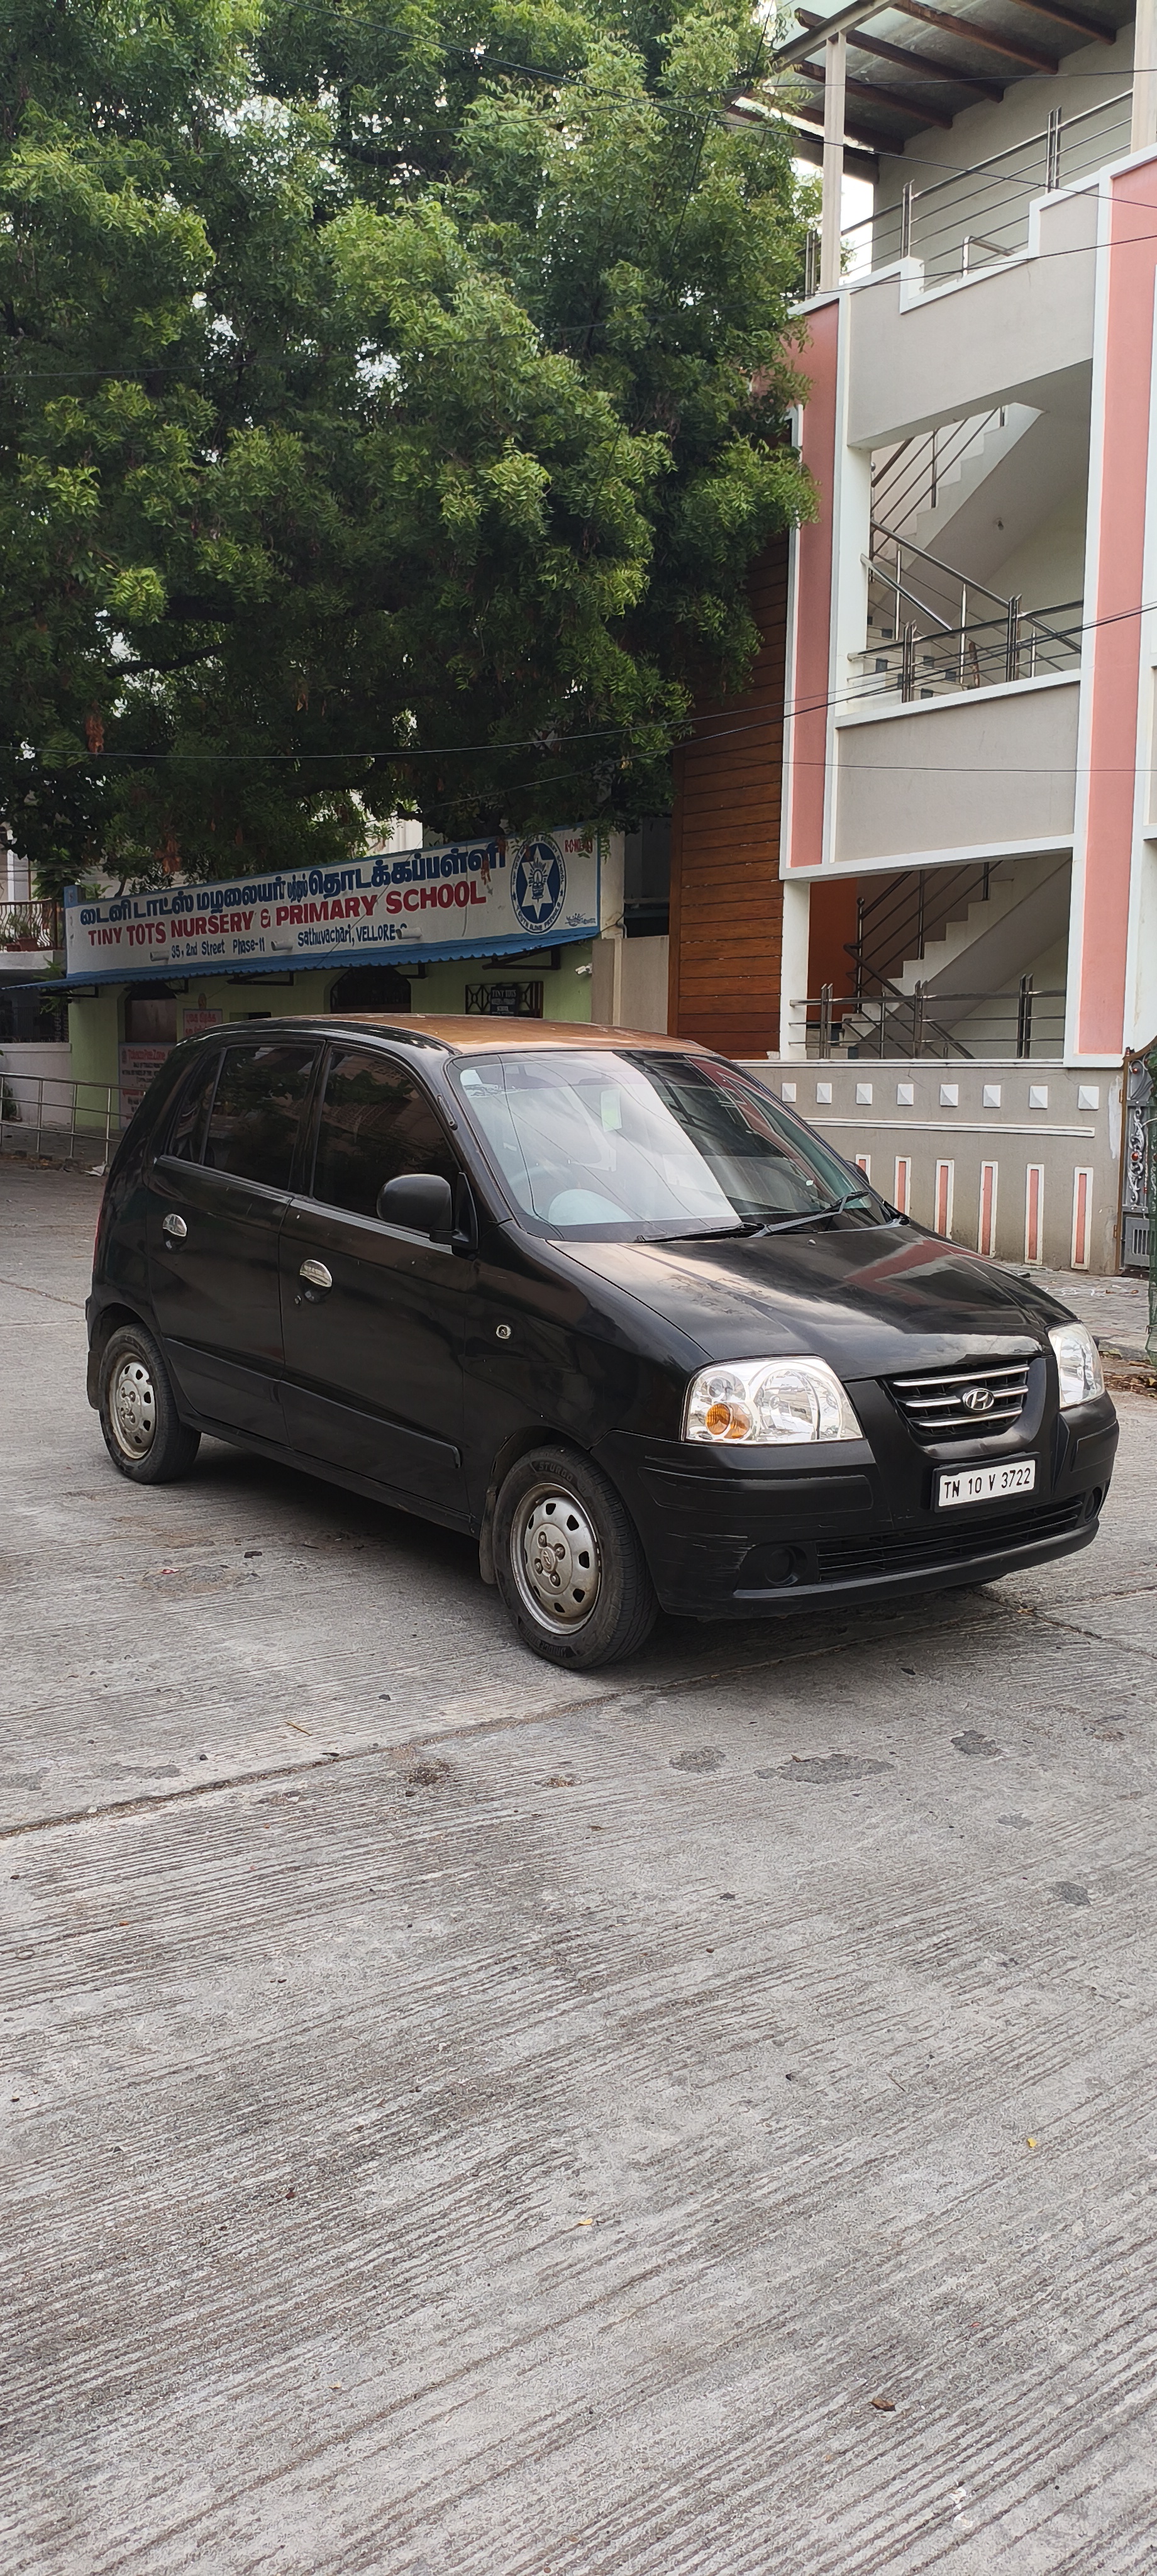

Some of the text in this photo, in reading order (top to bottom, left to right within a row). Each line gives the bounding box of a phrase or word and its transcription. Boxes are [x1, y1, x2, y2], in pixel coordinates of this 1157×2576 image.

[80, 899, 131, 926] டைனி
[134, 891, 194, 918] டாட்ஸ்
[197, 876, 286, 914] மழலையர்
[88, 880, 486, 946] TINY TOTS NURSERY & PRIMARY SCHOOL
[186, 941, 198, 956] 2nd
[201, 939, 225, 956] Street
[944, 1467, 1031, 1499] TN 10 V 3722
